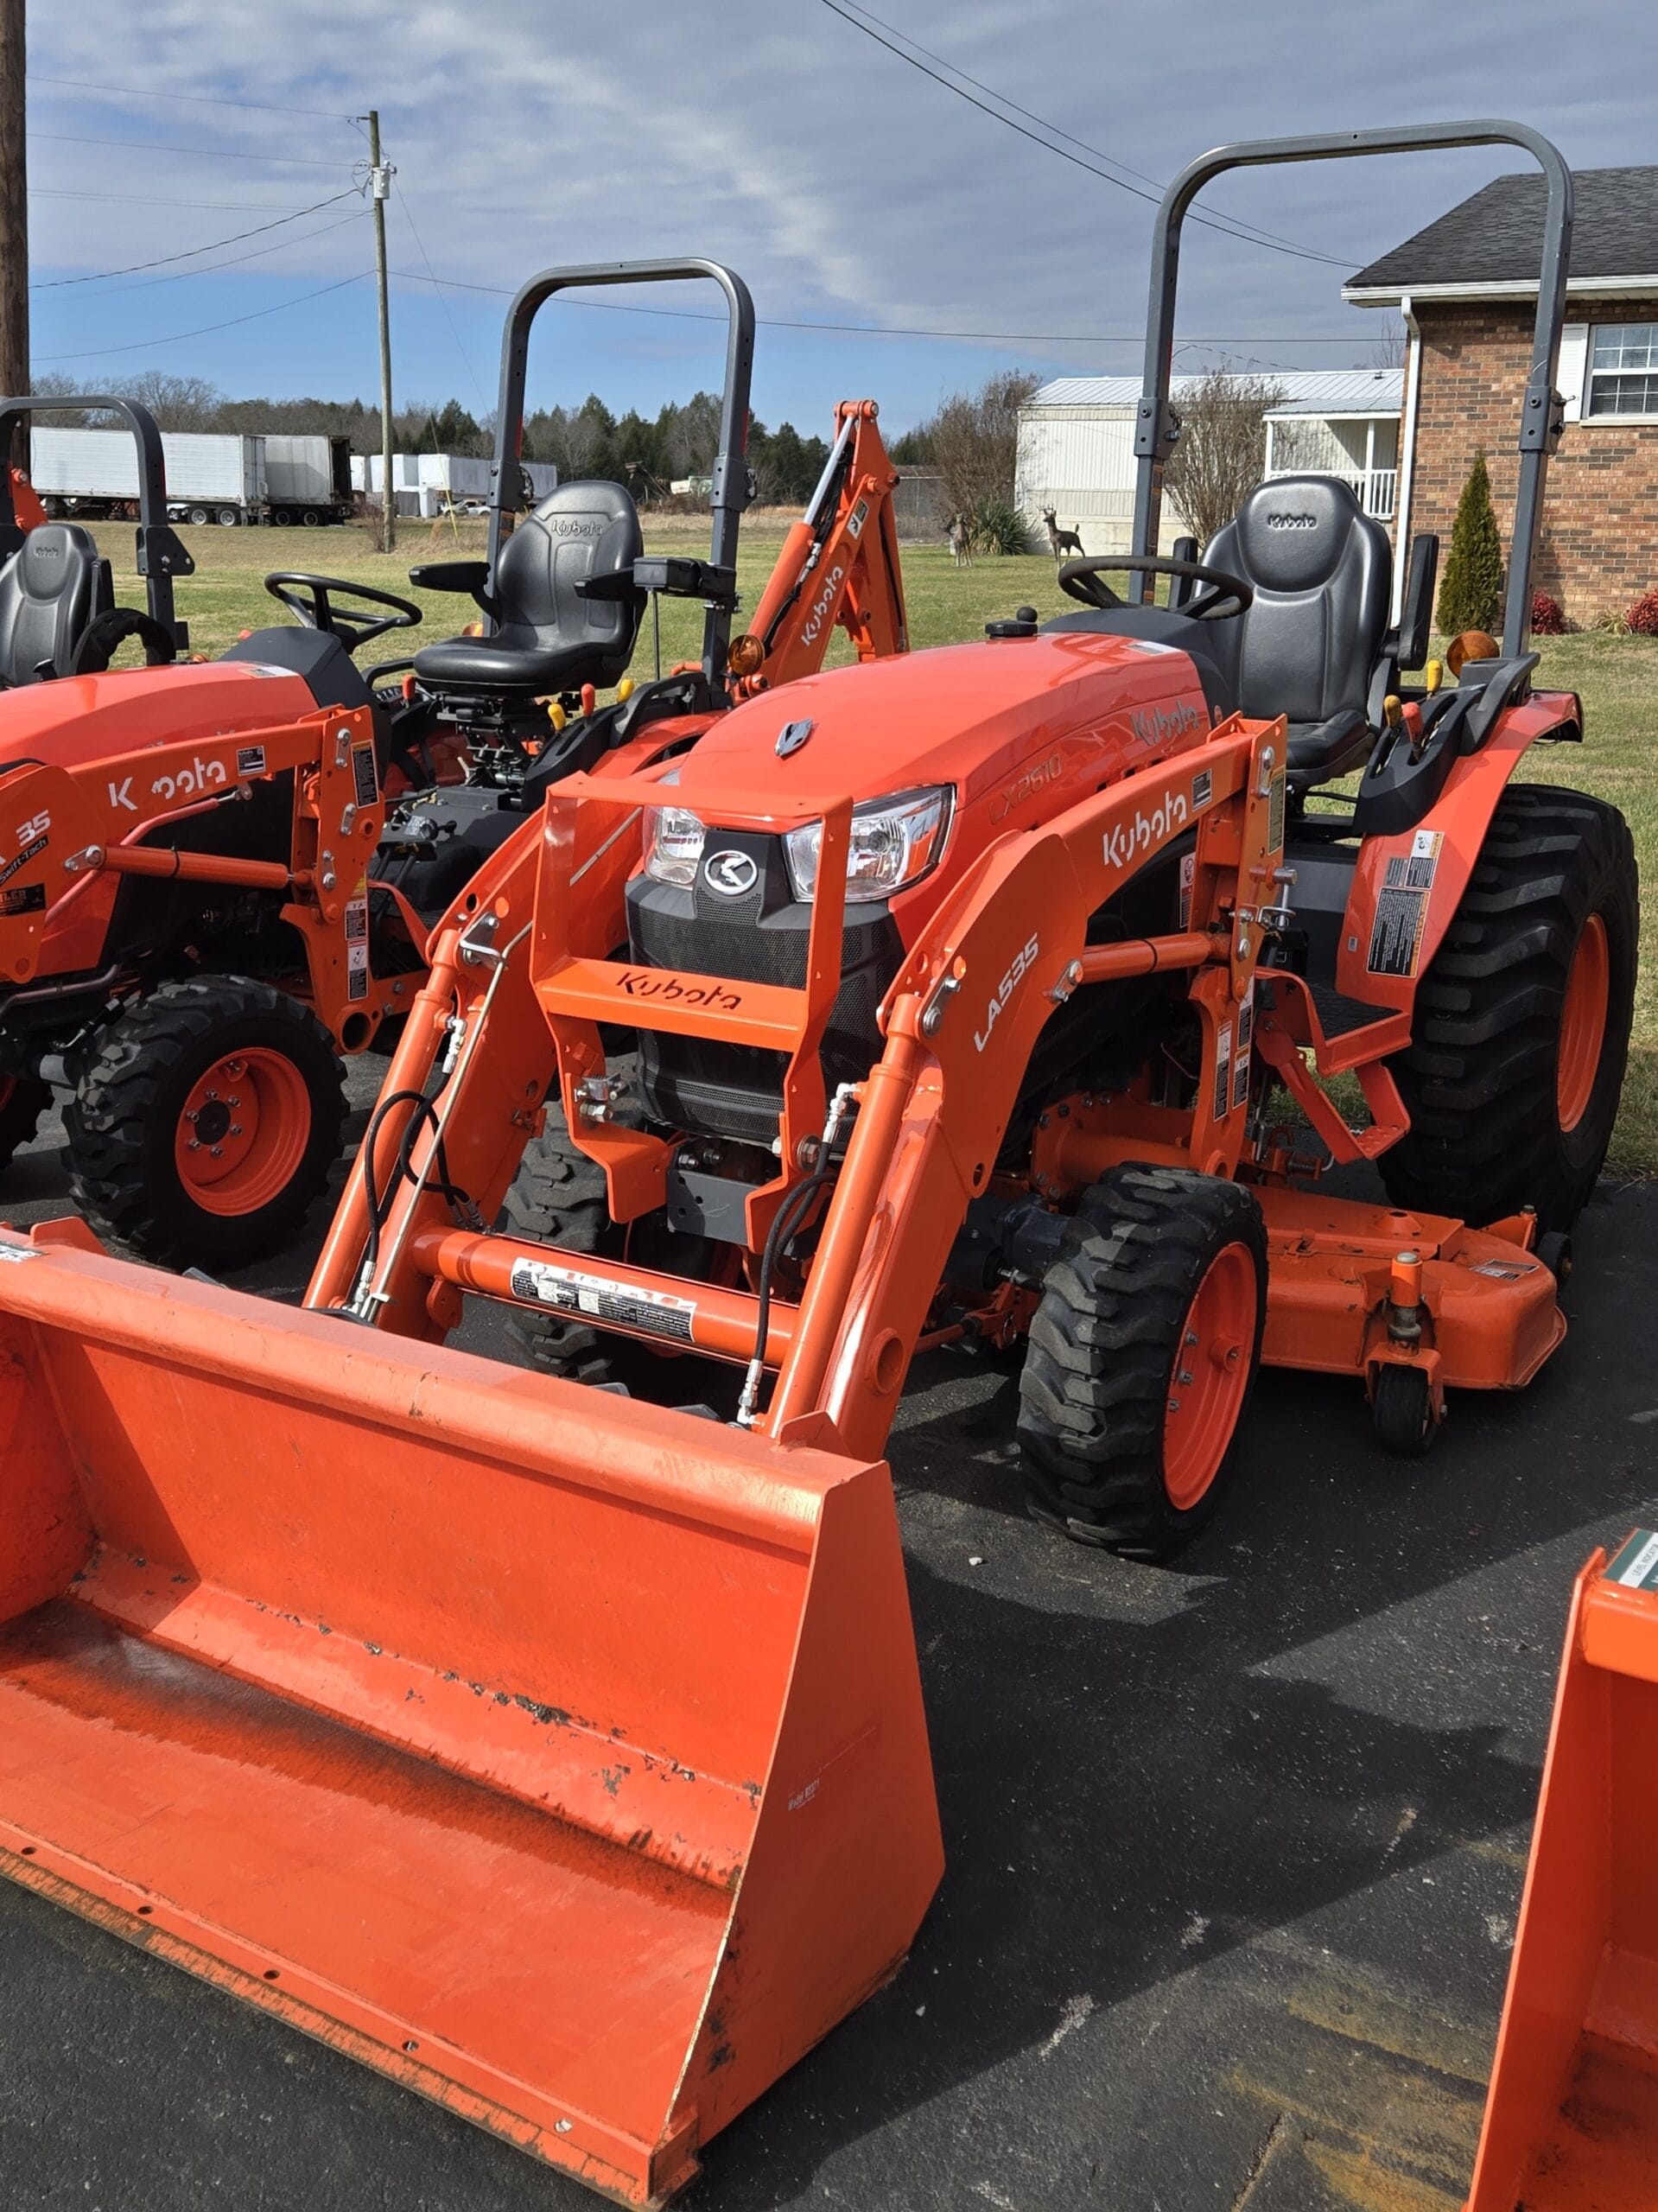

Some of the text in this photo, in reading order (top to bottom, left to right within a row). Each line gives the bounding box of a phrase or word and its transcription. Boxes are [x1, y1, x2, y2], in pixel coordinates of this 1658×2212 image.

[551, 520, 604, 537] Kubota
[1267, 512, 1317, 530] Kubota
[801, 566, 844, 646] Kubota
[1130, 700, 1200, 747] Kubota
[988, 753, 1063, 825] LX2610
[1102, 791, 1187, 869] Kubota
[615, 972, 742, 1010] Kubota
[974, 931, 1039, 1052] LA535
